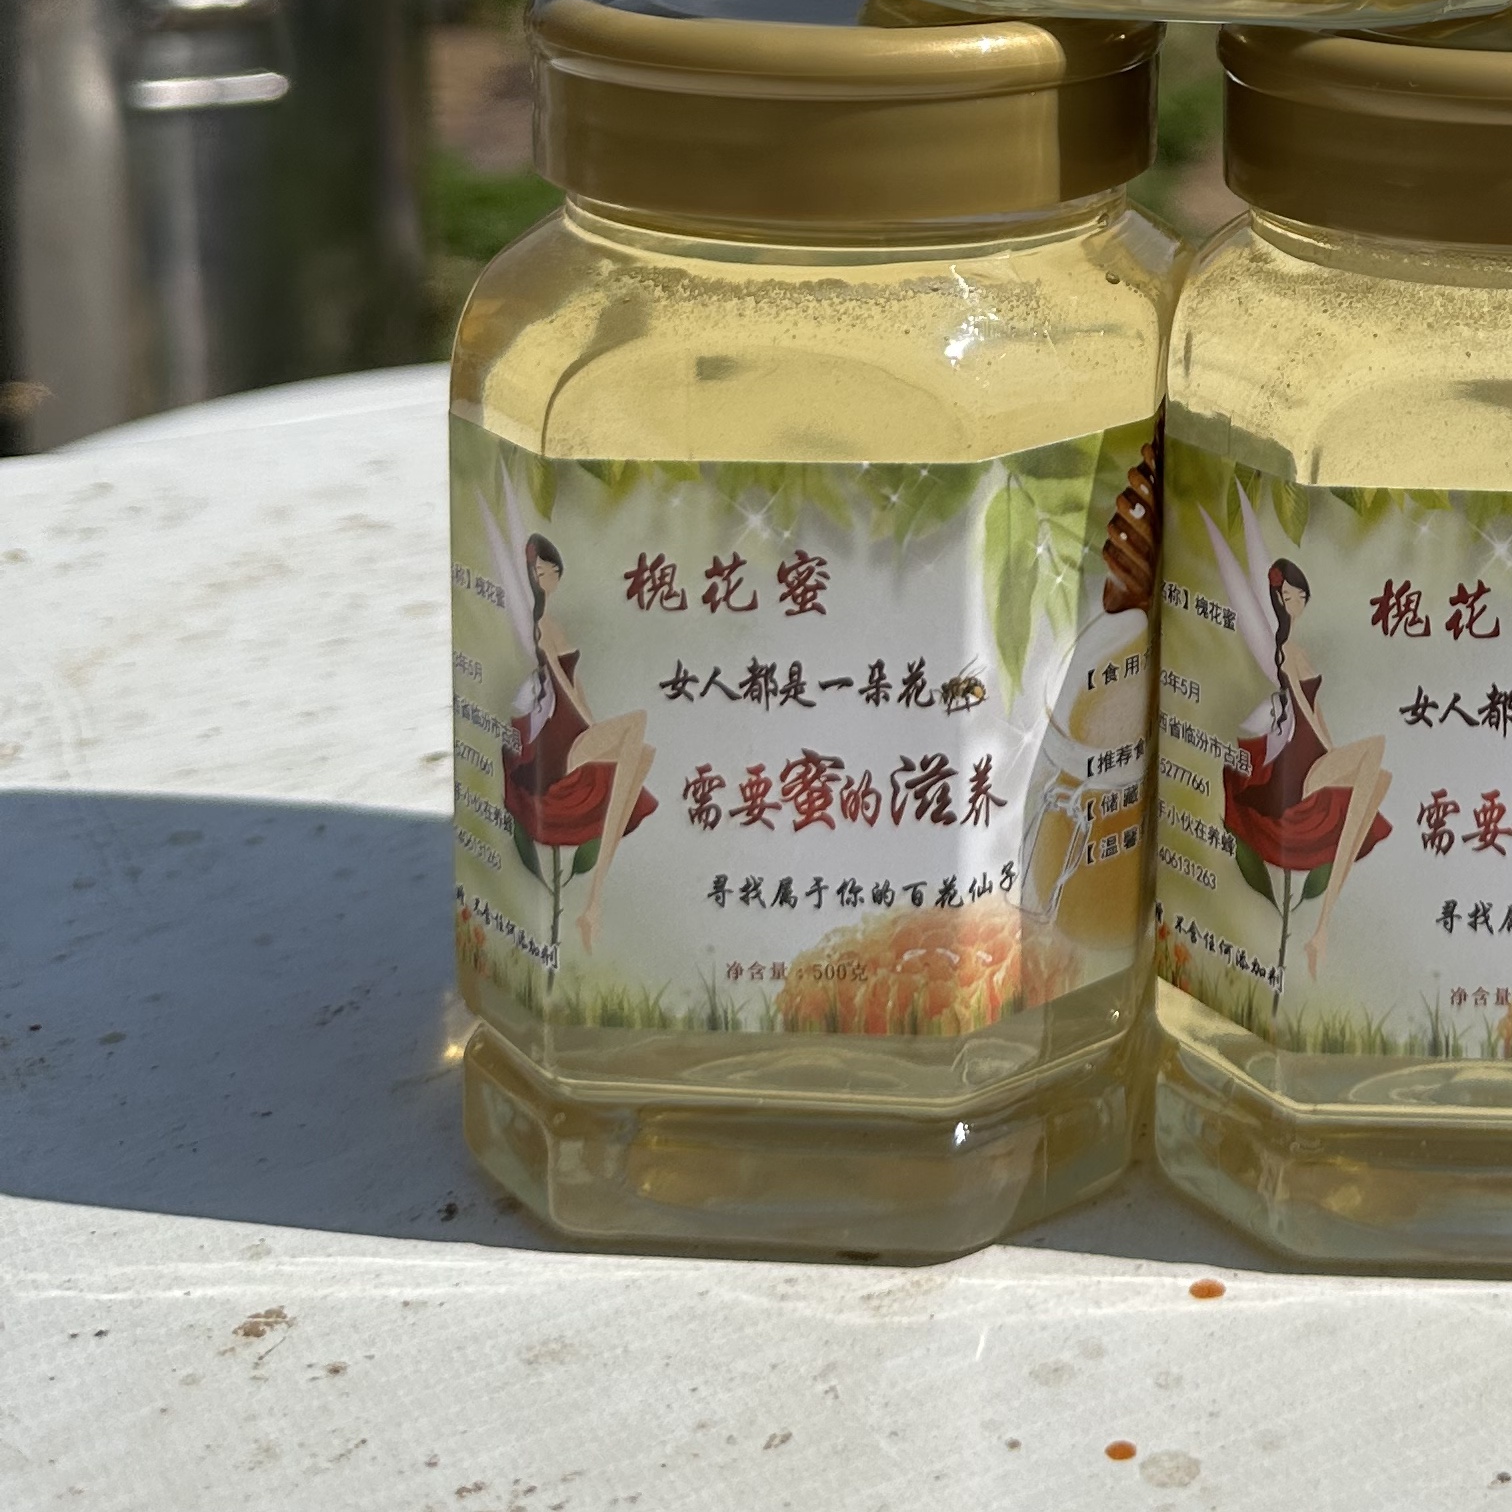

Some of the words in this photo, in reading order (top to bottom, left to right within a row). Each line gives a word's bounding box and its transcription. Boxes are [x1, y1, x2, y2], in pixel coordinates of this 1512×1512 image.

[623, 550, 830, 616] 槐花蜜
[658, 657, 943, 711] 女人都是一朵花
[682, 748, 1008, 831] 需要蜜的滋养
[705, 863, 1018, 910] 寻找属于你的百花仙子
